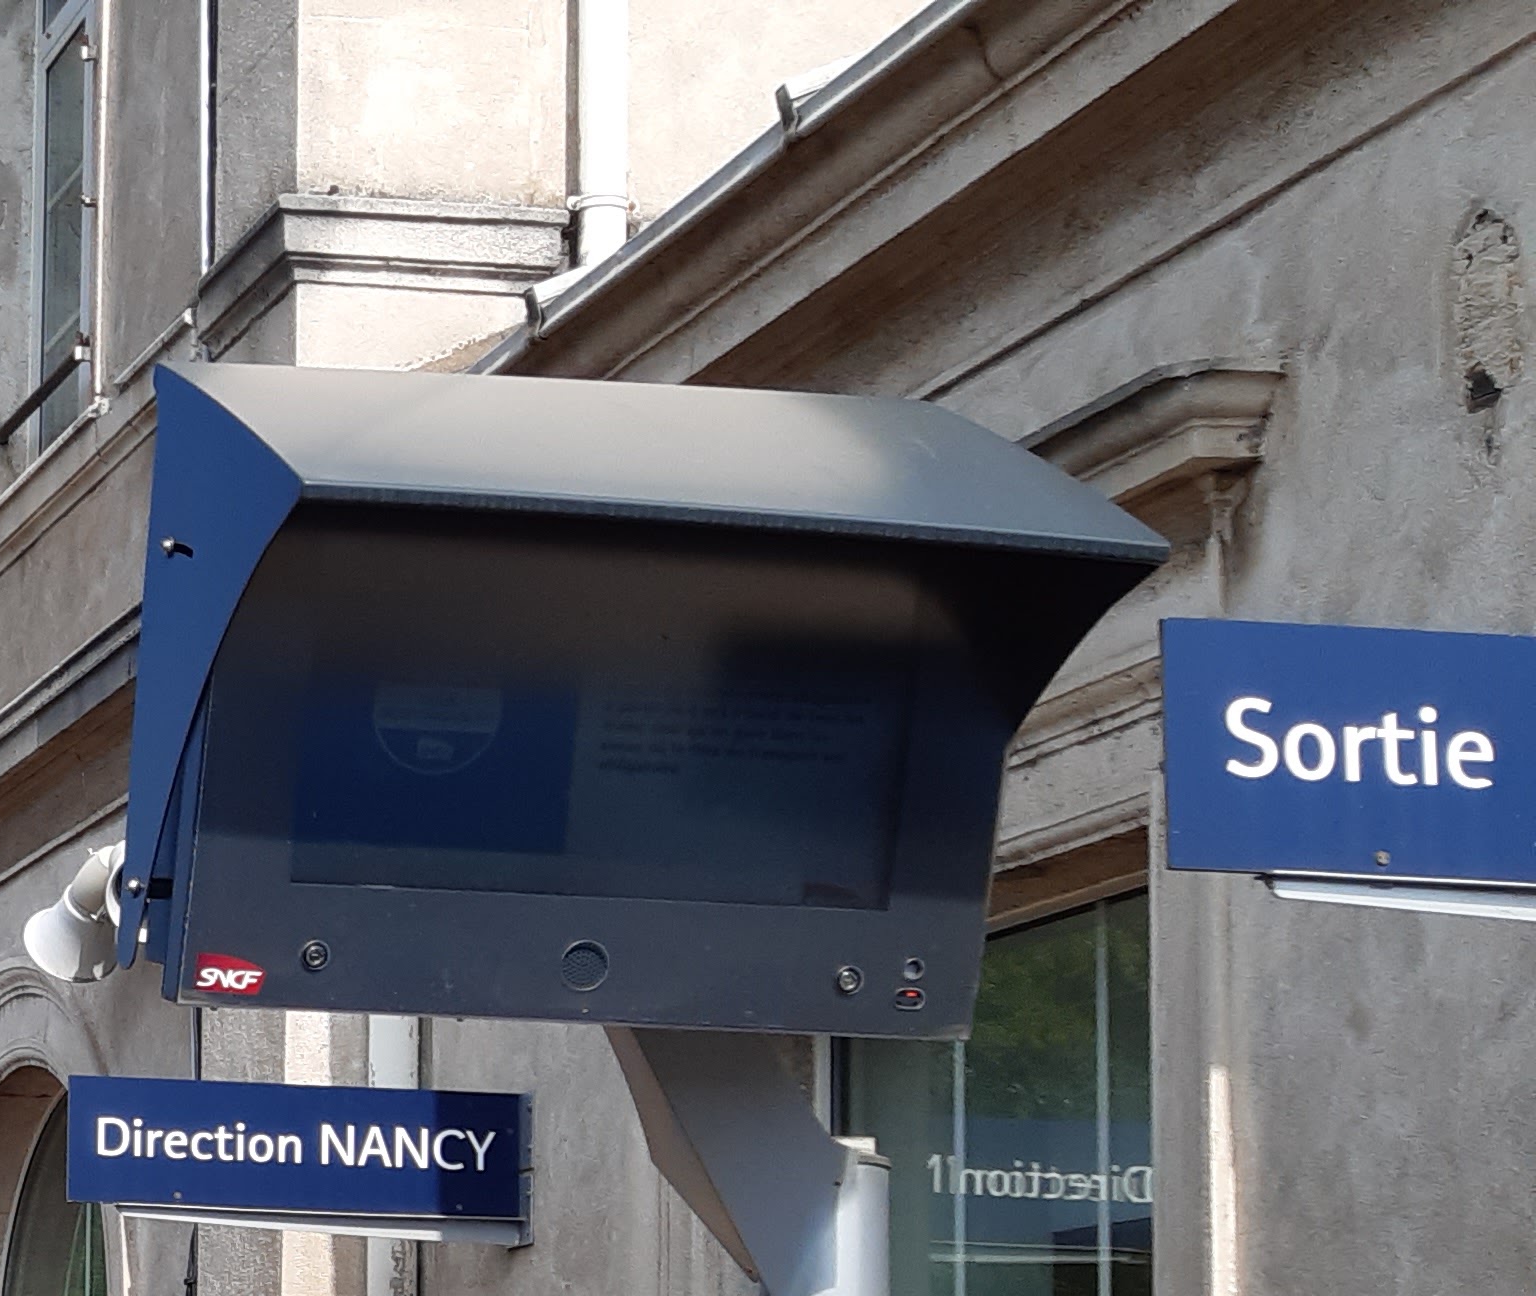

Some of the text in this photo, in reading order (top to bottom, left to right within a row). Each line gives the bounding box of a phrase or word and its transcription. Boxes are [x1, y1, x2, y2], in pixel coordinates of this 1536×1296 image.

[1224, 697, 1495, 790] Sortie
[196, 967, 263, 990] SNCF
[96, 1116, 496, 1172] Direction NANCY
